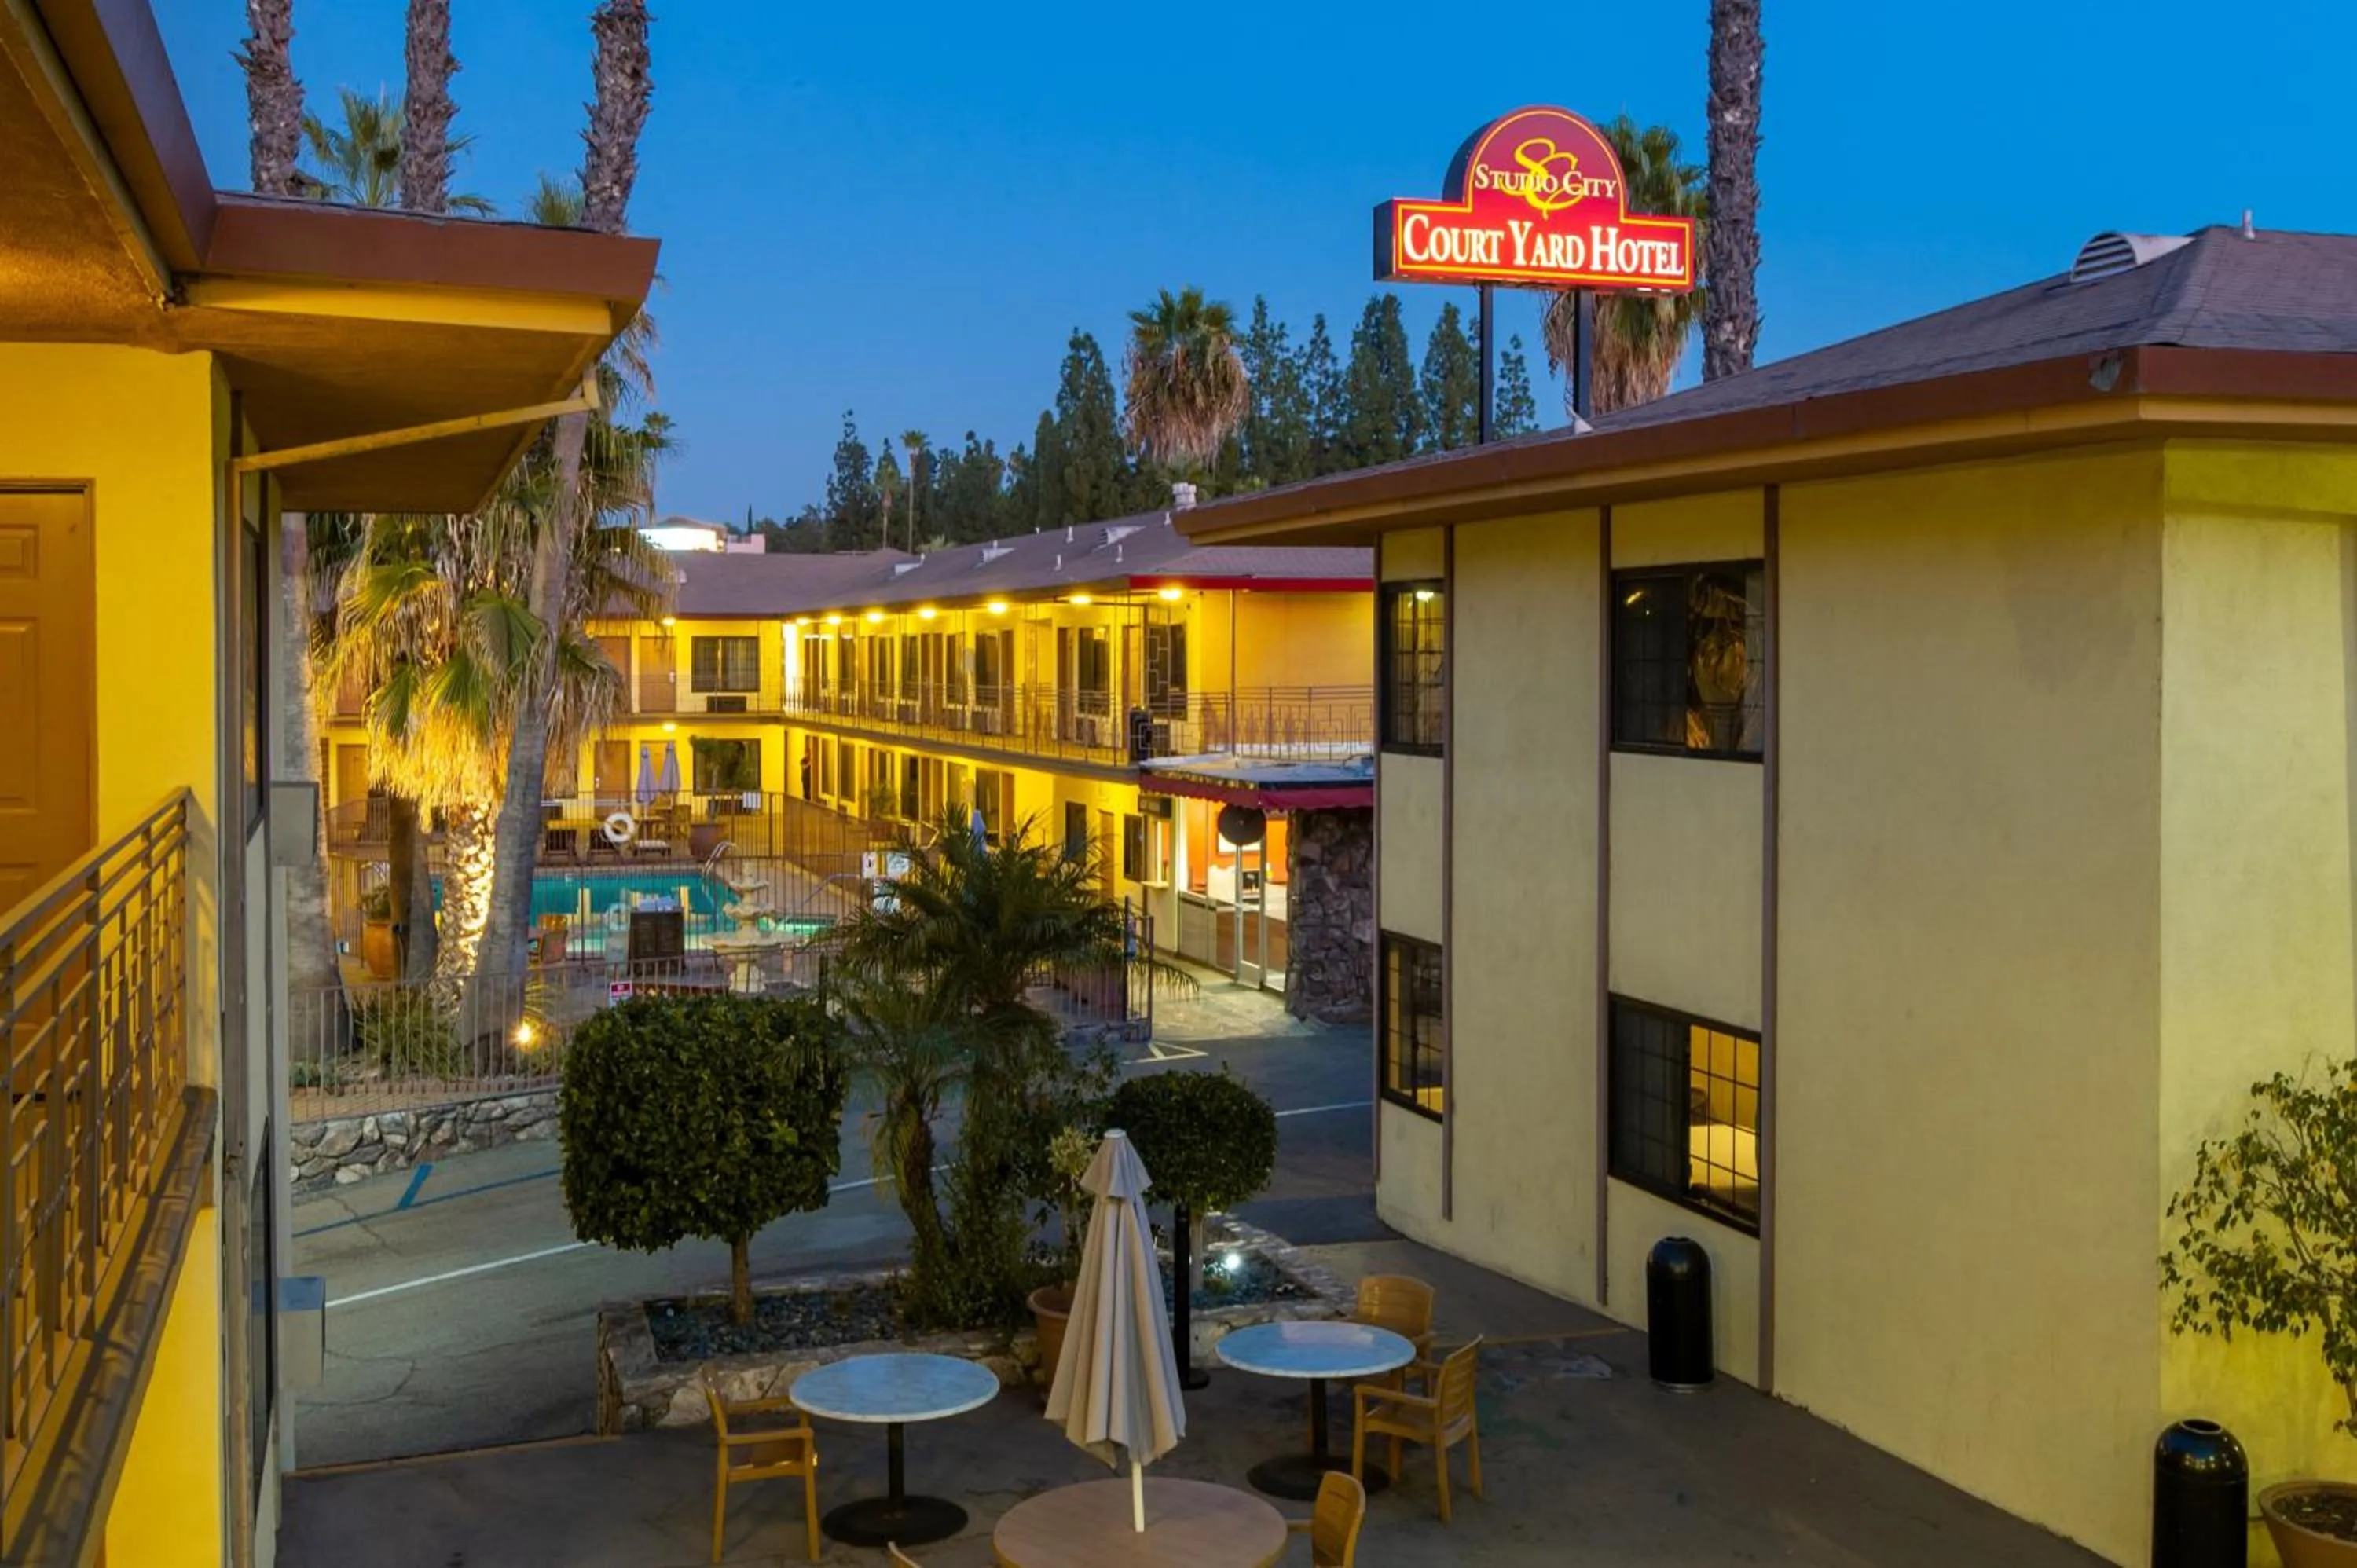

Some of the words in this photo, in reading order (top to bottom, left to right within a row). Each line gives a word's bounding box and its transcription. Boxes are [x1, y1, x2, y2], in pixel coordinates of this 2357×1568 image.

[1475, 163, 1558, 193] STUDIO
[1563, 170, 1617, 198] CITY
[1403, 214, 1505, 265] COURT
[1508, 219, 1585, 269] YARD
[1589, 225, 1684, 275] HOTEL
